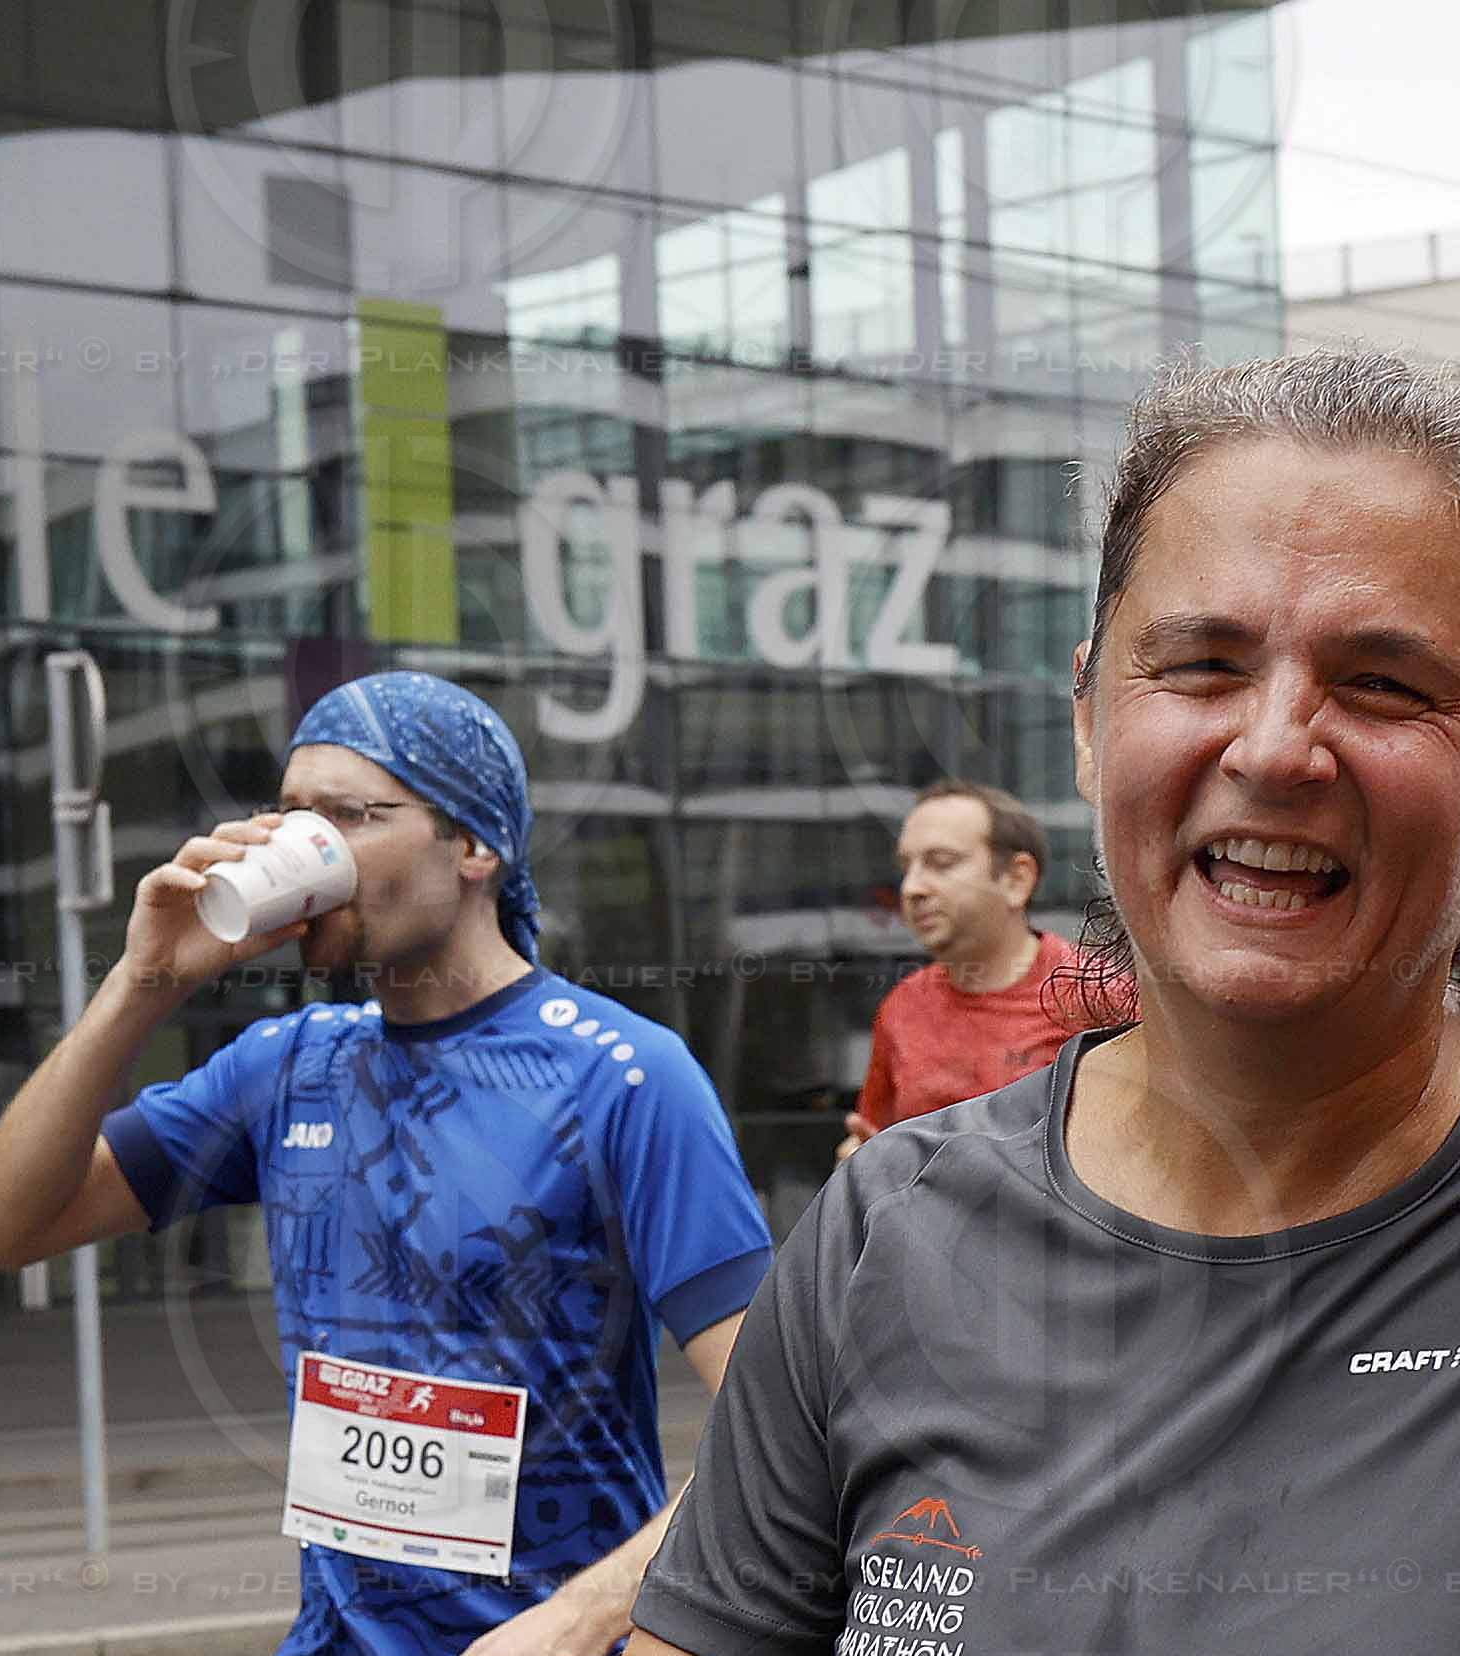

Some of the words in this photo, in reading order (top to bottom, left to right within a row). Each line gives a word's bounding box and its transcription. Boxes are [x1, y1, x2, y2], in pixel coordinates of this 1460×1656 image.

[518, 466, 961, 744] graz
[283, 1122, 335, 1149] JAKO
[1349, 1349, 1451, 1374] CRAFT
[341, 1425, 446, 1479] 2096
[355, 1490, 416, 1516] Gernot
[860, 1553, 974, 1597] ICELAND
